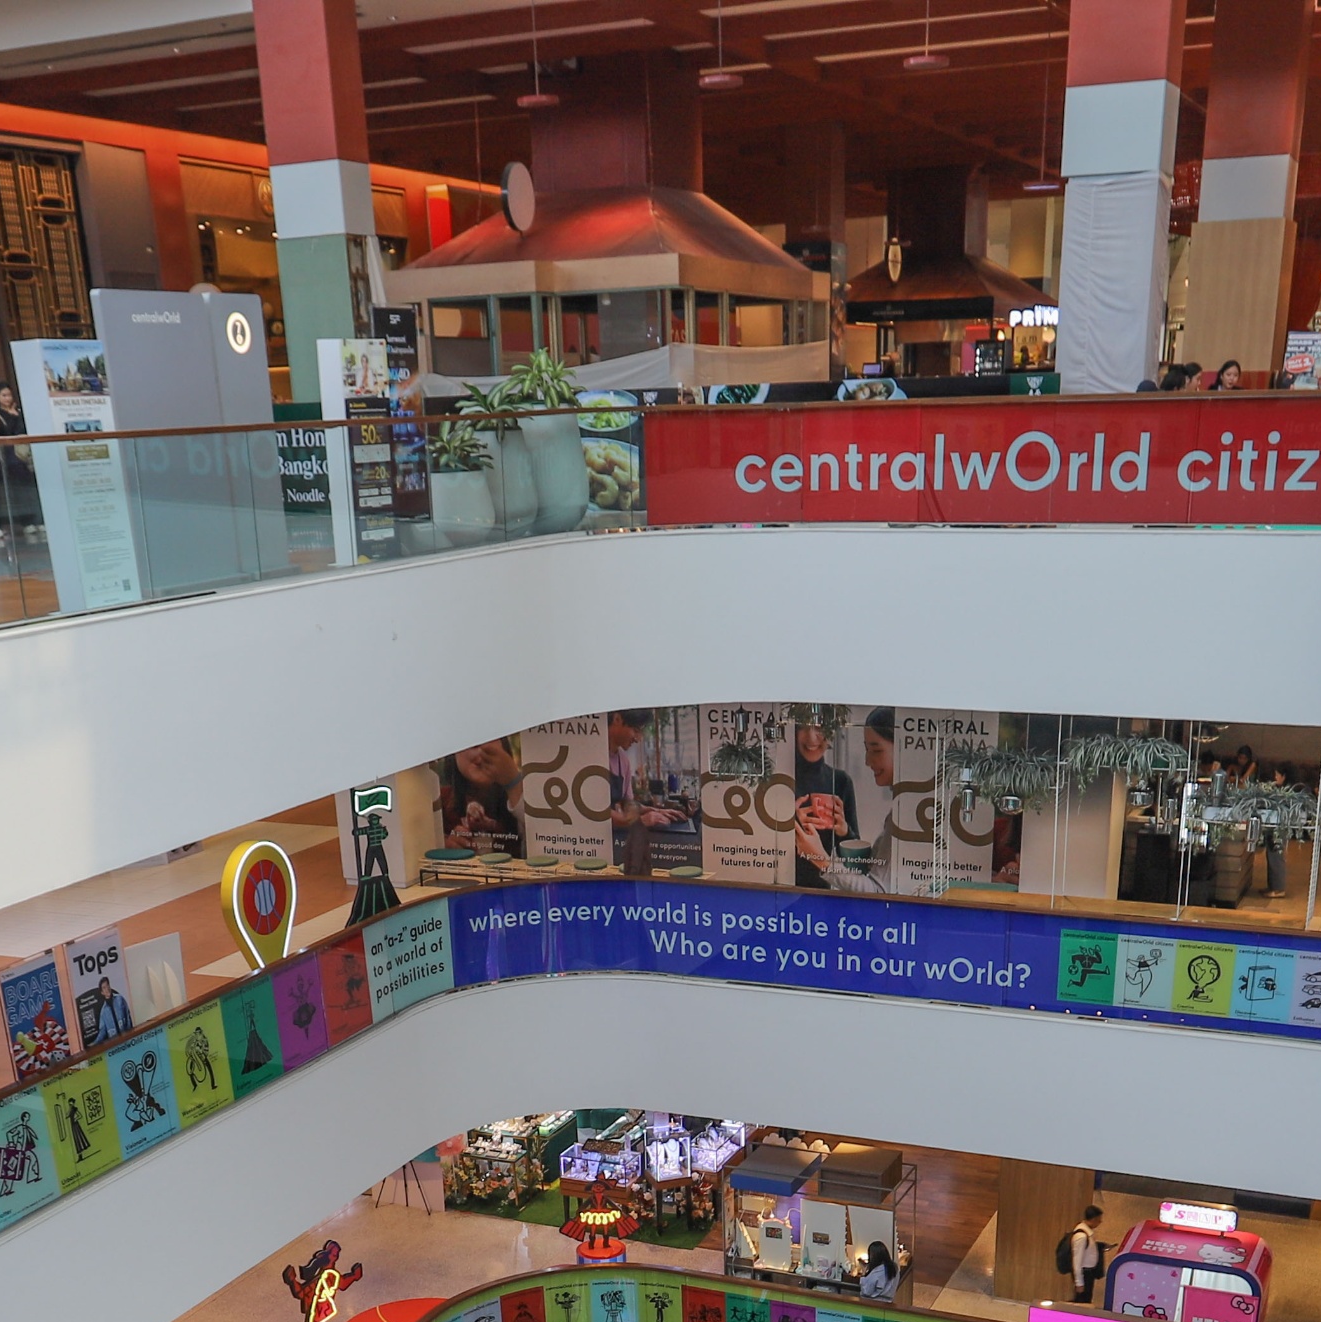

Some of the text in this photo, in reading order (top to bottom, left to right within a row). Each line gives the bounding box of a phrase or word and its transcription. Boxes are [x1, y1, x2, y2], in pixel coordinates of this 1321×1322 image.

[132, 311, 181, 324] centralwOrld
[1009, 308, 1059, 328] PRIM
[734, 431, 1150, 493] centralwOrld
[286, 488, 326, 503] Noodle
[903, 717, 990, 735] CENTRAL
[535, 832, 605, 847] Imagining better
[658, 841, 702, 852] opportunities
[543, 845, 597, 857] futures for all
[658, 852, 688, 863] everyone
[712, 843, 787, 859] Imagining better
[721, 857, 778, 869] futures for all
[847, 854, 886, 866] technology
[952, 860, 982, 873] better
[469, 902, 917, 946] where every world is possible for all
[370, 940, 384, 957] an
[410, 916, 443, 945] guide
[73, 945, 119, 976] Tops
[373, 938, 443, 978] to a world of
[649, 929, 1031, 989] Who are you in our wOrld?
[5, 967, 59, 1008] BOARD
[376, 959, 444, 1005] possibilities
[7, 989, 55, 1028] GAME
[1142, 1245, 1186, 1256] KITTY
[1145, 1239, 1188, 1250] HELLO
